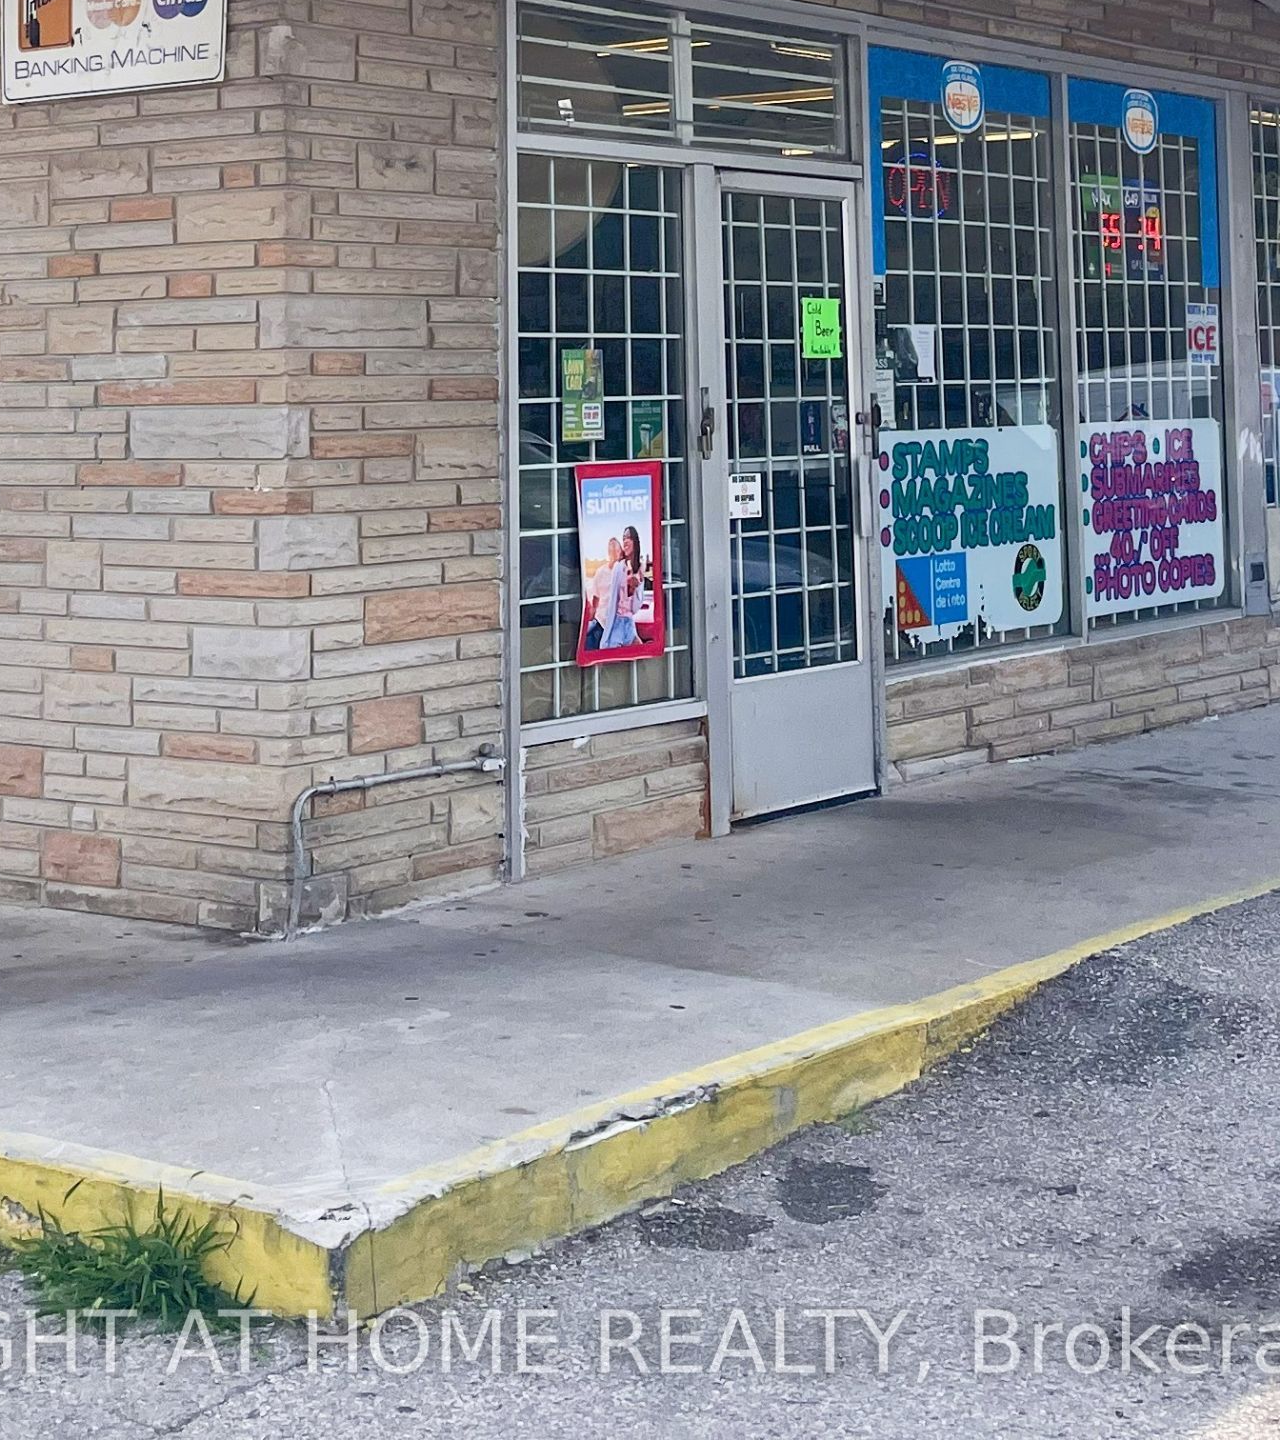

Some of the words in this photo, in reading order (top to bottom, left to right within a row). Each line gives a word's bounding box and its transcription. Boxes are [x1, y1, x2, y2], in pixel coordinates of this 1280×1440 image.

[15, 54, 104, 79] BANKING
[110, 43, 210, 70] MACHINE
[815, 319, 834, 337] Beer
[1188, 324, 1217, 351] ICE
[892, 438, 990, 481] STAMPS
[1089, 429, 1148, 466] CHIPS
[1165, 428, 1194, 461] ICE
[891, 471, 1029, 518] MAGAZINES
[1090, 460, 1201, 501] SUBMARINES
[586, 495, 649, 515] summer
[1092, 495, 1168, 535] GREETING
[1168, 489, 1217, 526] CARDS
[892, 513, 958, 555] SCOOP
[960, 509, 990, 549] ICE
[988, 504, 1055, 546] CREAM
[1149, 525, 1180, 561] OFF
[935, 558, 956, 572] Lotto
[1094, 560, 1157, 602] PHOTO
[1158, 553, 1216, 594] COPIES
